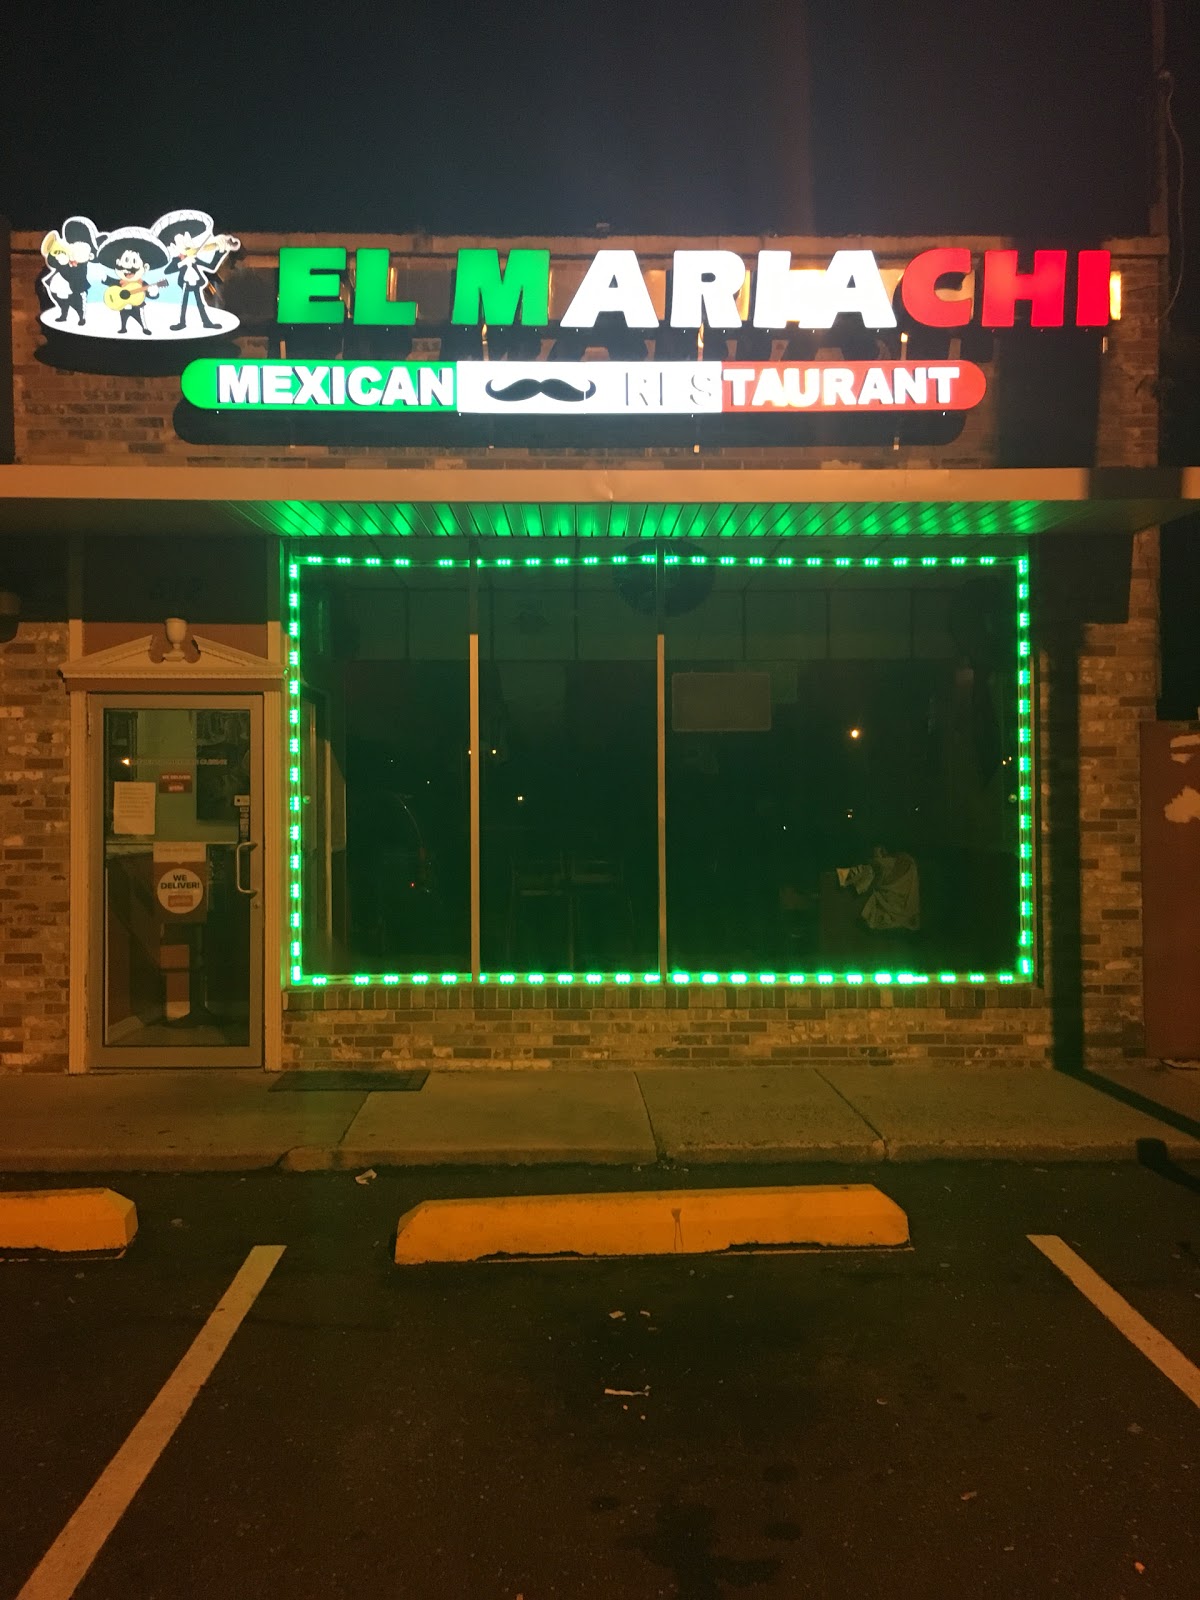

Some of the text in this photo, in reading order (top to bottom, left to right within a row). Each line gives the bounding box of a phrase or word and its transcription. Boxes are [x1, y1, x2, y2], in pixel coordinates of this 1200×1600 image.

[278, 247, 1111, 328] EL MARIACHI
[217, 364, 454, 406] MEXICAN
[160, 882, 200, 890] DELIVER!
[173, 874, 187, 882] WE
